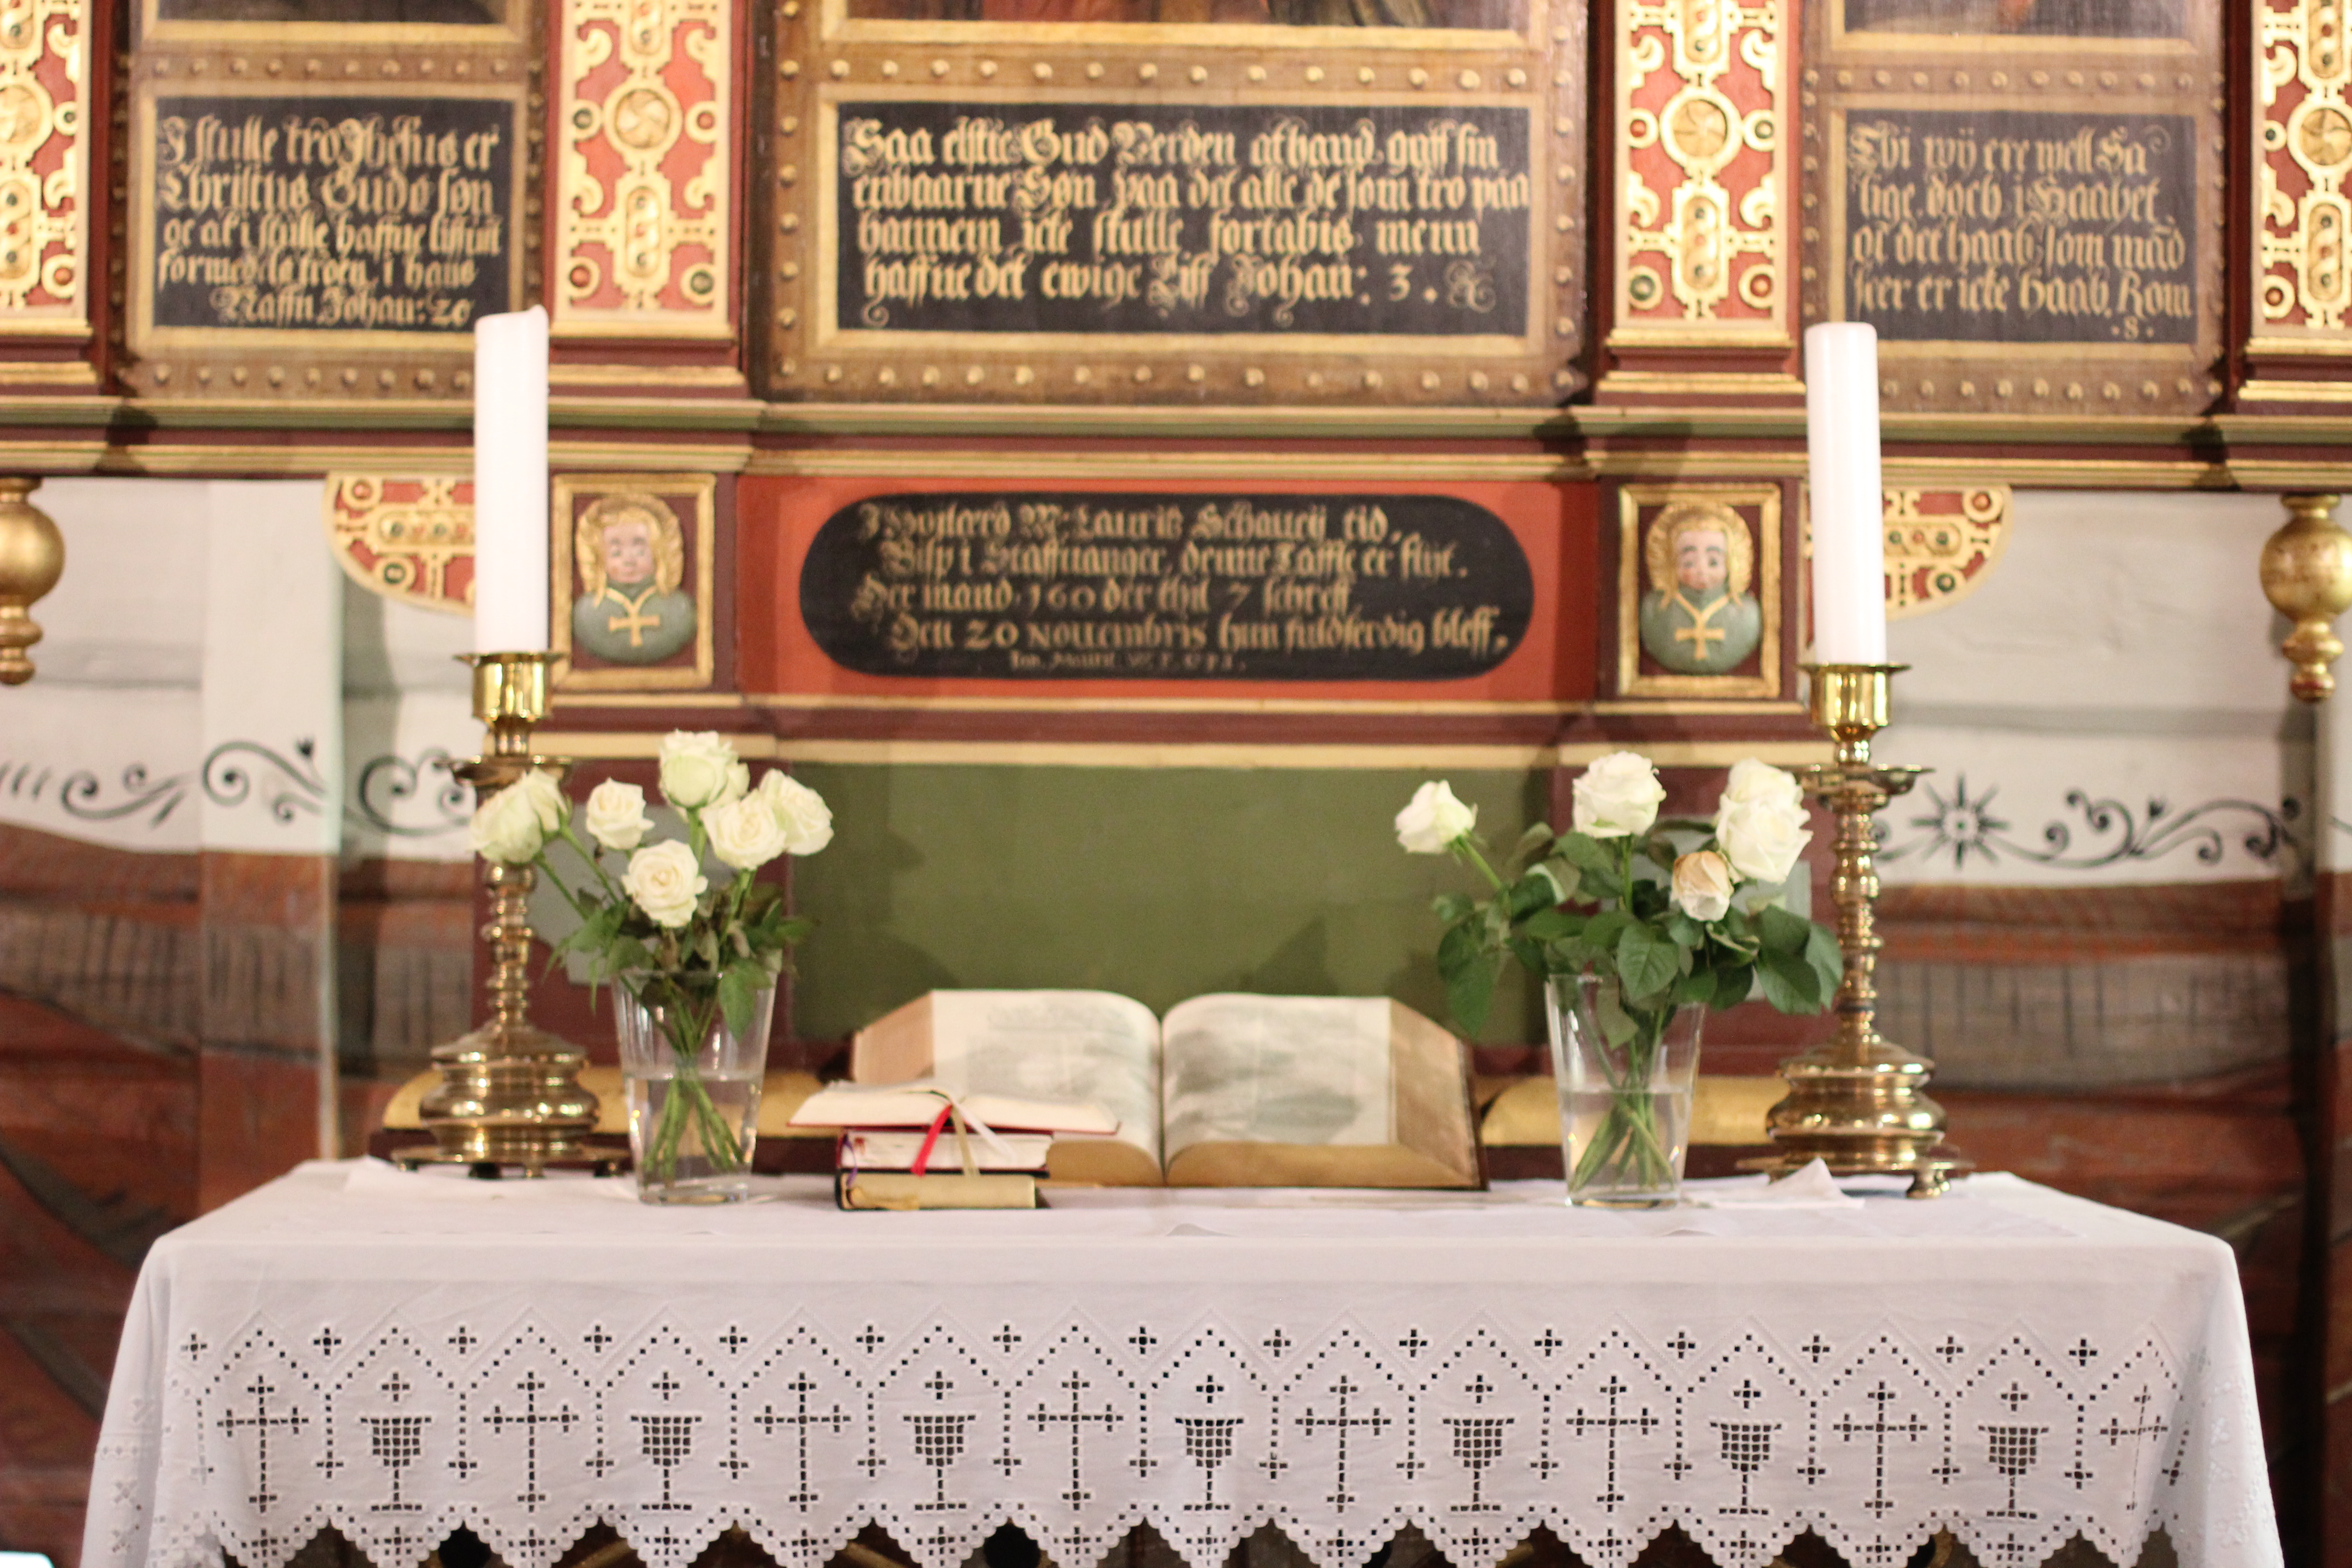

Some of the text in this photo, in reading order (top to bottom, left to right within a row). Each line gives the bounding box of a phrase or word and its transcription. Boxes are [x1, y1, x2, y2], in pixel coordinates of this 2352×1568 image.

[284, 116, 338, 166] tro
[464, 129, 500, 171] er
[843, 117, 936, 176] Saa
[1022, 119, 1110, 167] Gud
[1112, 120, 1237, 167] Verden
[1387, 123, 1452, 176] gaff
[1455, 122, 1499, 175] sin
[320, 166, 431, 217] Guds
[853, 169, 1014, 210] enbaarne
[1014, 164, 1097, 214] Søn
[1112, 168, 1181, 213] paa
[1240, 169, 1298, 210] alle
[1303, 169, 1341, 211] de
[1346, 168, 1412, 222] som
[1415, 170, 1468, 212] tro
[1471, 172, 1530, 223] paa
[201, 212, 240, 250] at
[240, 212, 253, 250] i
[858, 211, 1002, 259] hannem
[1023, 212, 1073, 254] icke
[1094, 208, 1184, 263] skulle
[2044, 224, 2105, 276] som
[862, 255, 972, 320] haffue
[975, 254, 1029, 301] det
[1040, 261, 1142, 311] ewige
[1147, 253, 1212, 313] Liff
[1917, 274, 1954, 313] er
[1957, 265, 2011, 314] icke
[1362, 546, 1395, 577] er
[963, 619, 1020, 651] 20
